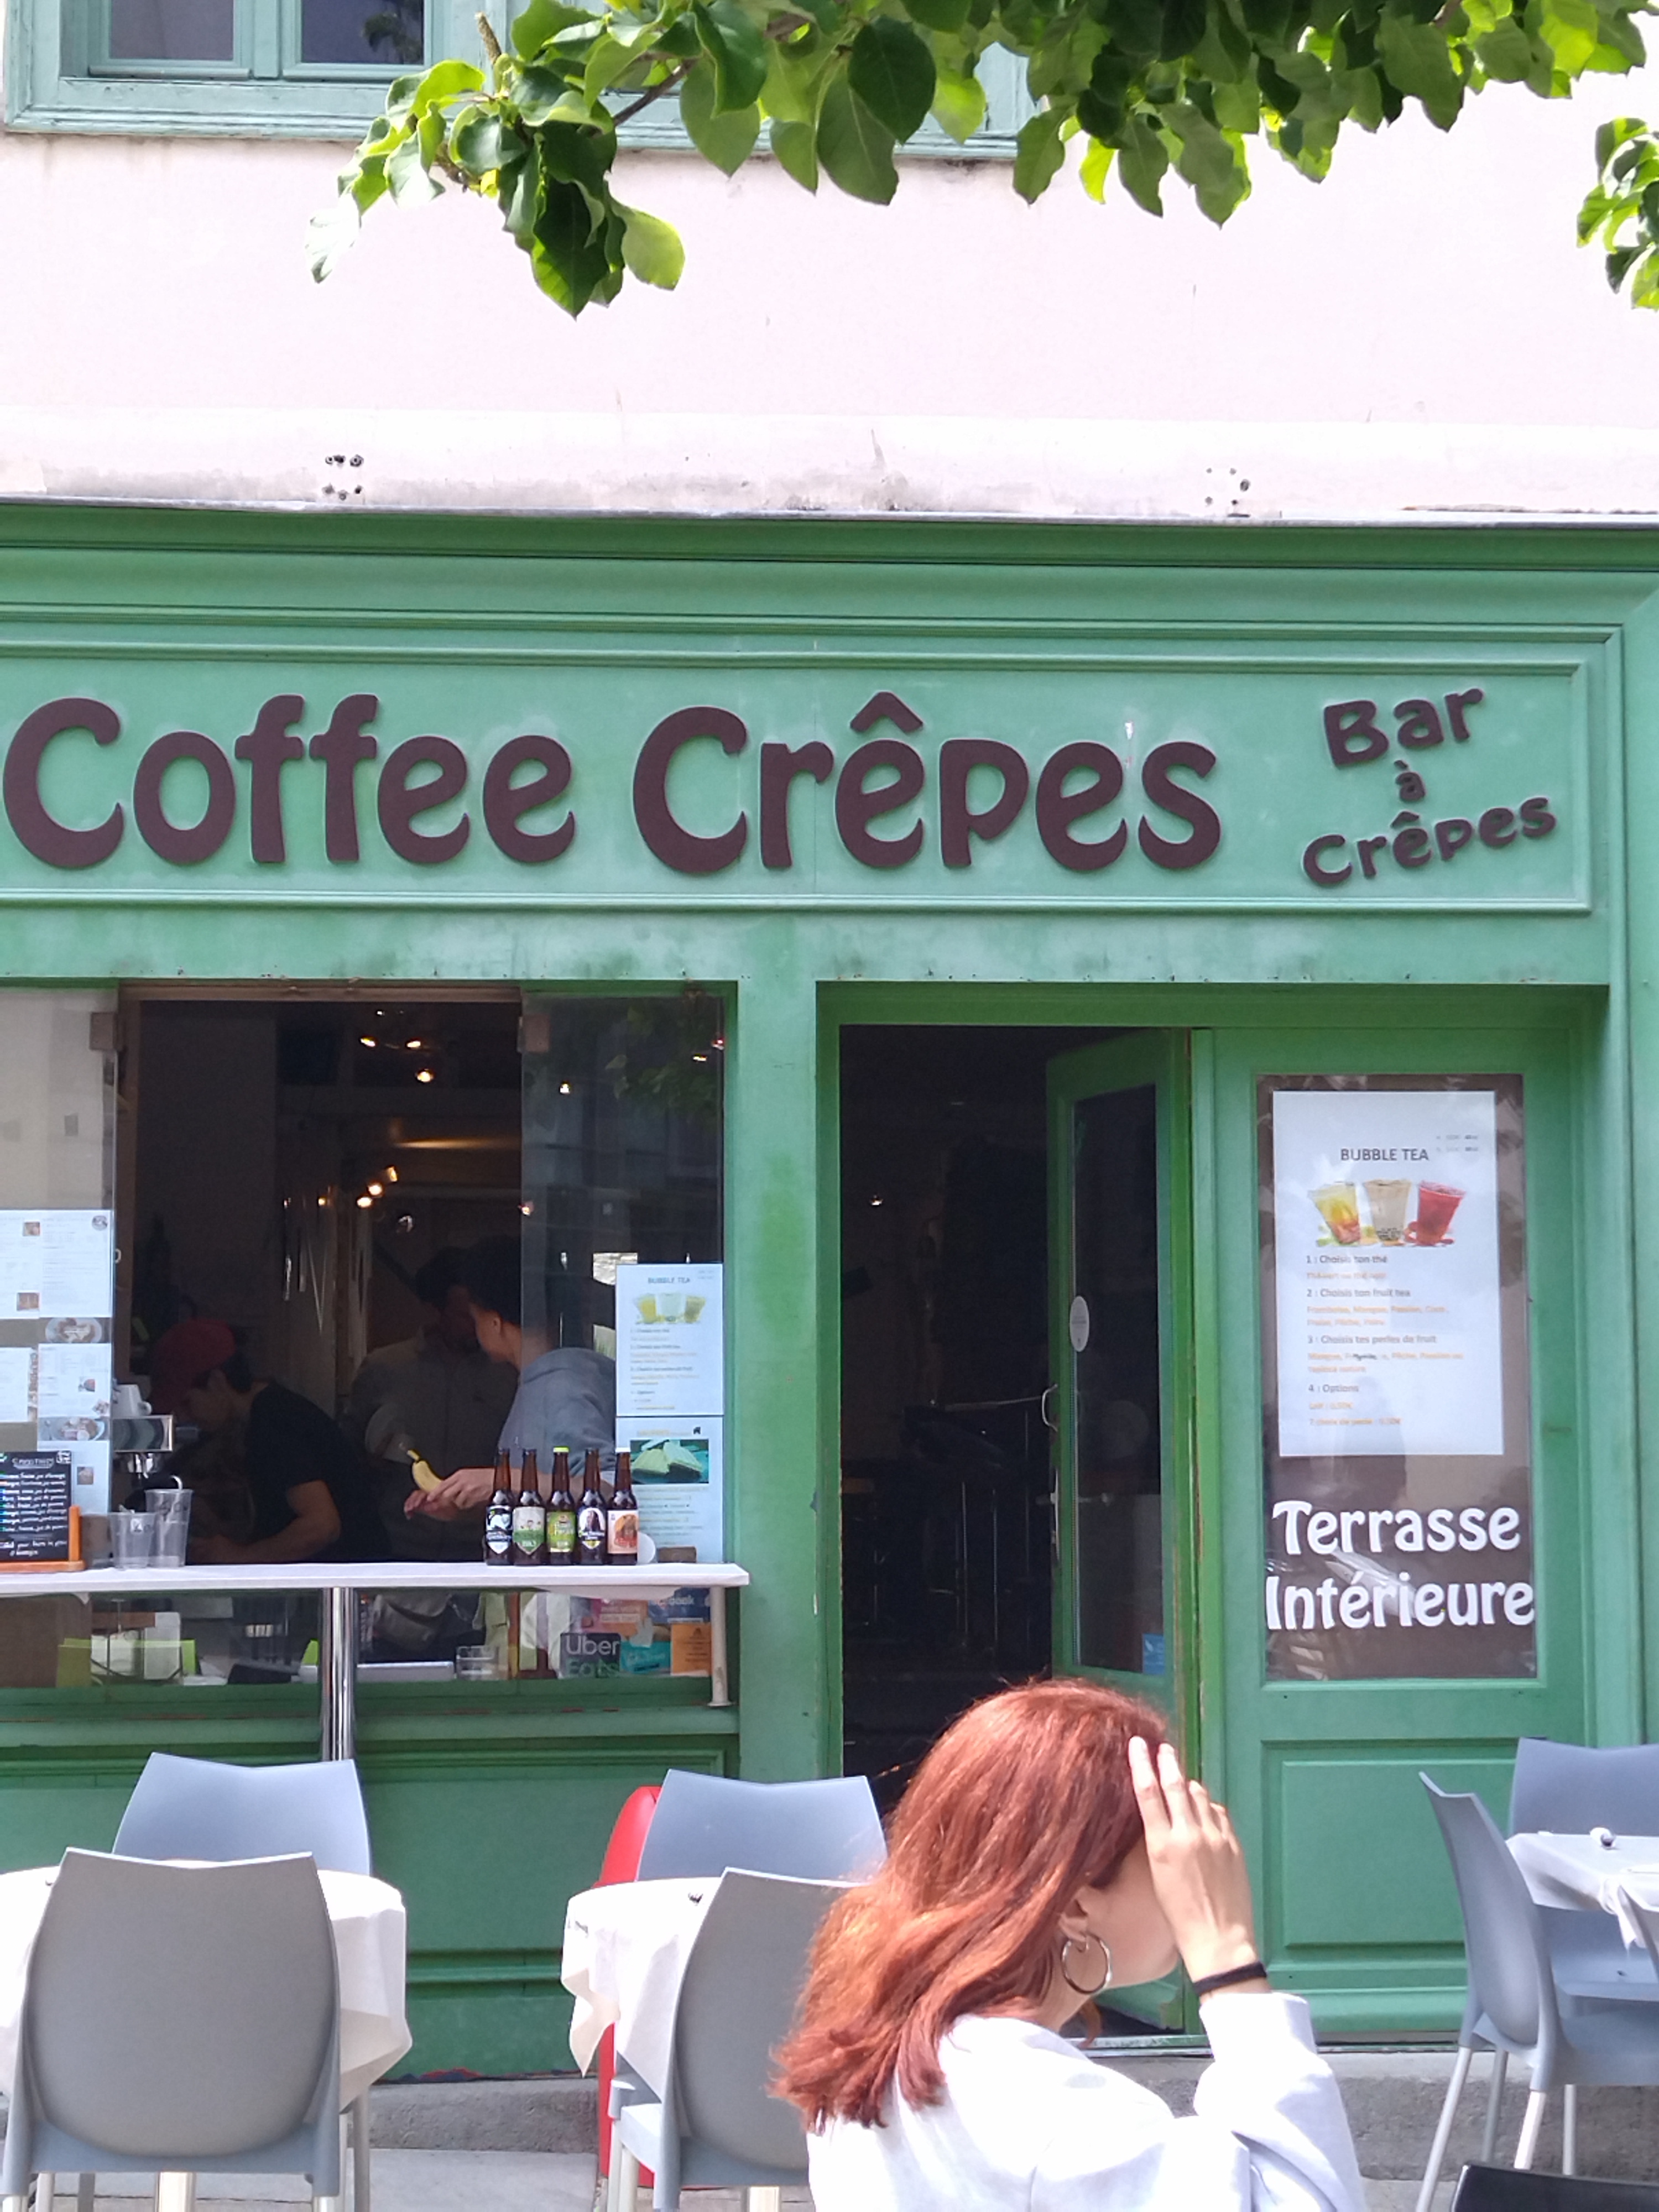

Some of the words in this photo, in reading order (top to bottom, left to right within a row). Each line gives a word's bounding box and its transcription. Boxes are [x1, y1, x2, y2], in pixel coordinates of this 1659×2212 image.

[1323, 688, 1484, 768] Bar
[3, 693, 576, 869] Coffee
[633, 691, 1222, 874] Crêpes
[1395, 760, 1426, 802] à
[1302, 797, 1557, 886] Crêpes
[1340, 1148, 1397, 1161] BUBBLE
[1402, 1148, 1430, 1161] TEA
[1272, 1500, 1520, 1555] Terrasse
[1266, 1571, 1535, 1630] Intérieure
[566, 1635, 620, 1655] Uber
